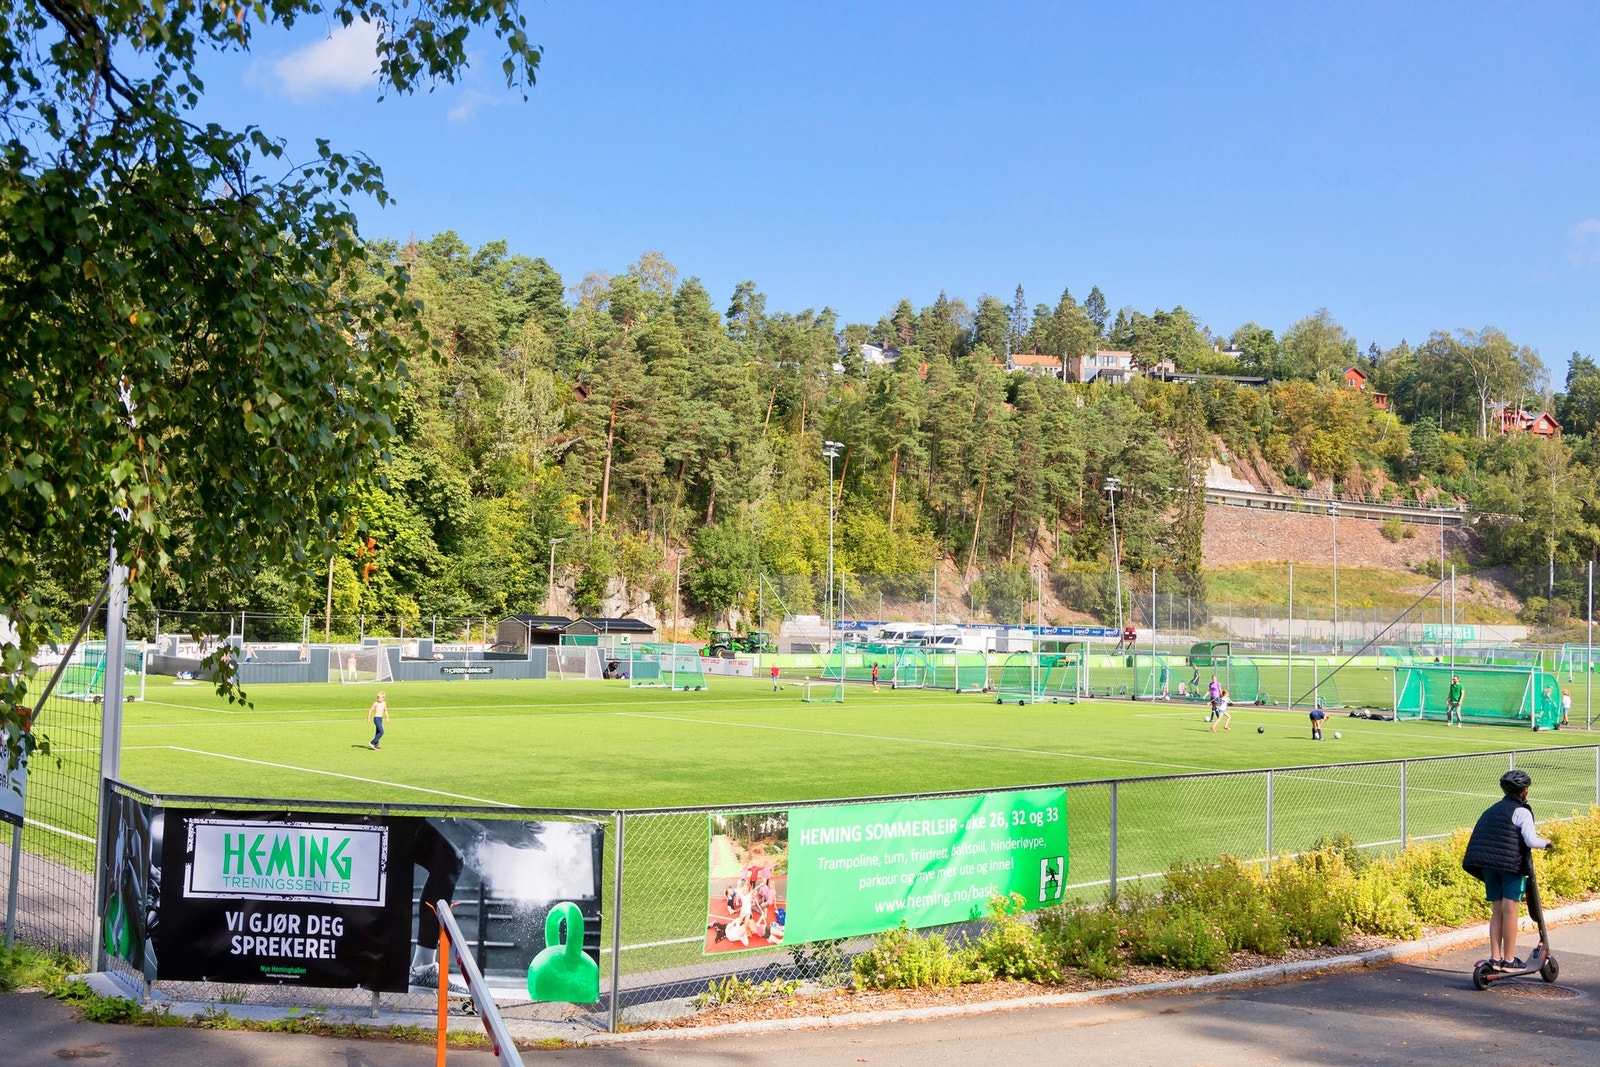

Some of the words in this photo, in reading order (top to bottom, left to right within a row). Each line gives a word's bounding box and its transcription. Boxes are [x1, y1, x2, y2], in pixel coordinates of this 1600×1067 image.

[800, 825, 863, 847] HEMING
[865, 817, 958, 841] SOMMERLEIR
[989, 811, 1009, 830] 26,
[1011, 810, 1027, 826] 32
[1029, 811, 1044, 827] og
[1046, 807, 1059, 822] 33
[222, 833, 352, 880] HEMING
[817, 853, 882, 871] Trampoline,
[951, 839, 988, 857] ballspill,
[990, 836, 1047, 852] hinderløype,
[222, 876, 351, 893] TRENINGSSENTER
[859, 873, 898, 891] parkour
[900, 872, 915, 886] og
[937, 866, 957, 878] mer
[960, 863, 976, 875] ute
[977, 862, 988, 875] og
[990, 857, 1015, 871] inne!
[225, 911, 244, 932] VI
[249, 912, 301, 935] GJØR
[307, 914, 344, 937] DEG
[230, 935, 336, 959] SPREKERE!
[260, 965, 271, 974] Nye
